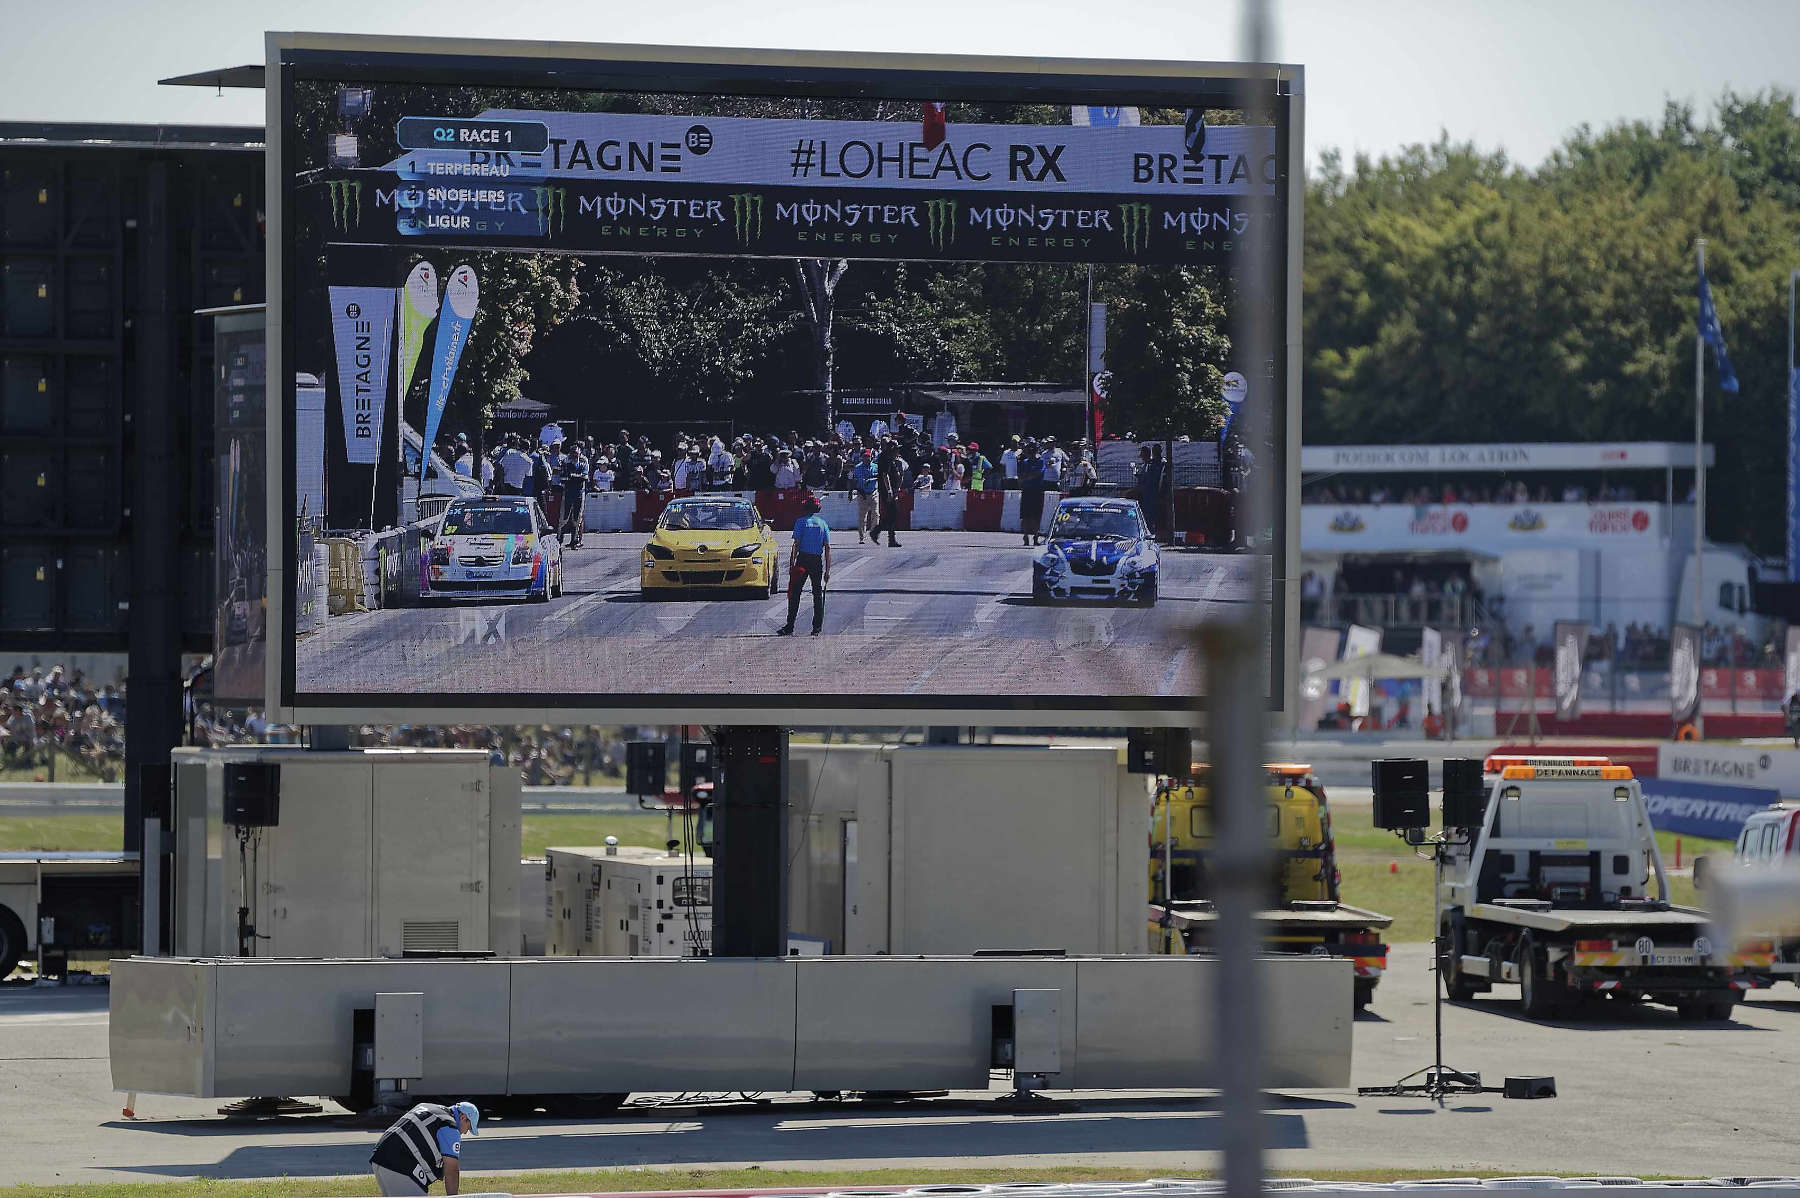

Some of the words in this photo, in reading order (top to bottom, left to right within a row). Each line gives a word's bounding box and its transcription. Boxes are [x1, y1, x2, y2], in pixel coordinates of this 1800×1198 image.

[433, 127, 455, 141] Q2
[459, 129, 500, 143] RACE
[505, 130, 512, 143] 1
[408, 160, 416, 173] 1
[427, 162, 510, 177] TERPEREAU
[790, 139, 992, 181] #LOHEAC
[1009, 144, 1067, 182] RX
[427, 187, 505, 202] SNOEIJERS
[579, 192, 726, 222] MONSTER
[775, 199, 920, 229] MONSTER
[428, 214, 471, 228] LIGUR
[968, 203, 1114, 232] MONSTER
[602, 225, 704, 238] ENERGY
[798, 231, 899, 244] ENERGY
[991, 236, 1092, 249] ENERGY
[355, 321, 371, 438] BRETAGNE
[1536, 768, 1602, 777] DEPANNAGE
[1672, 756, 1756, 778] BRETAGNE
